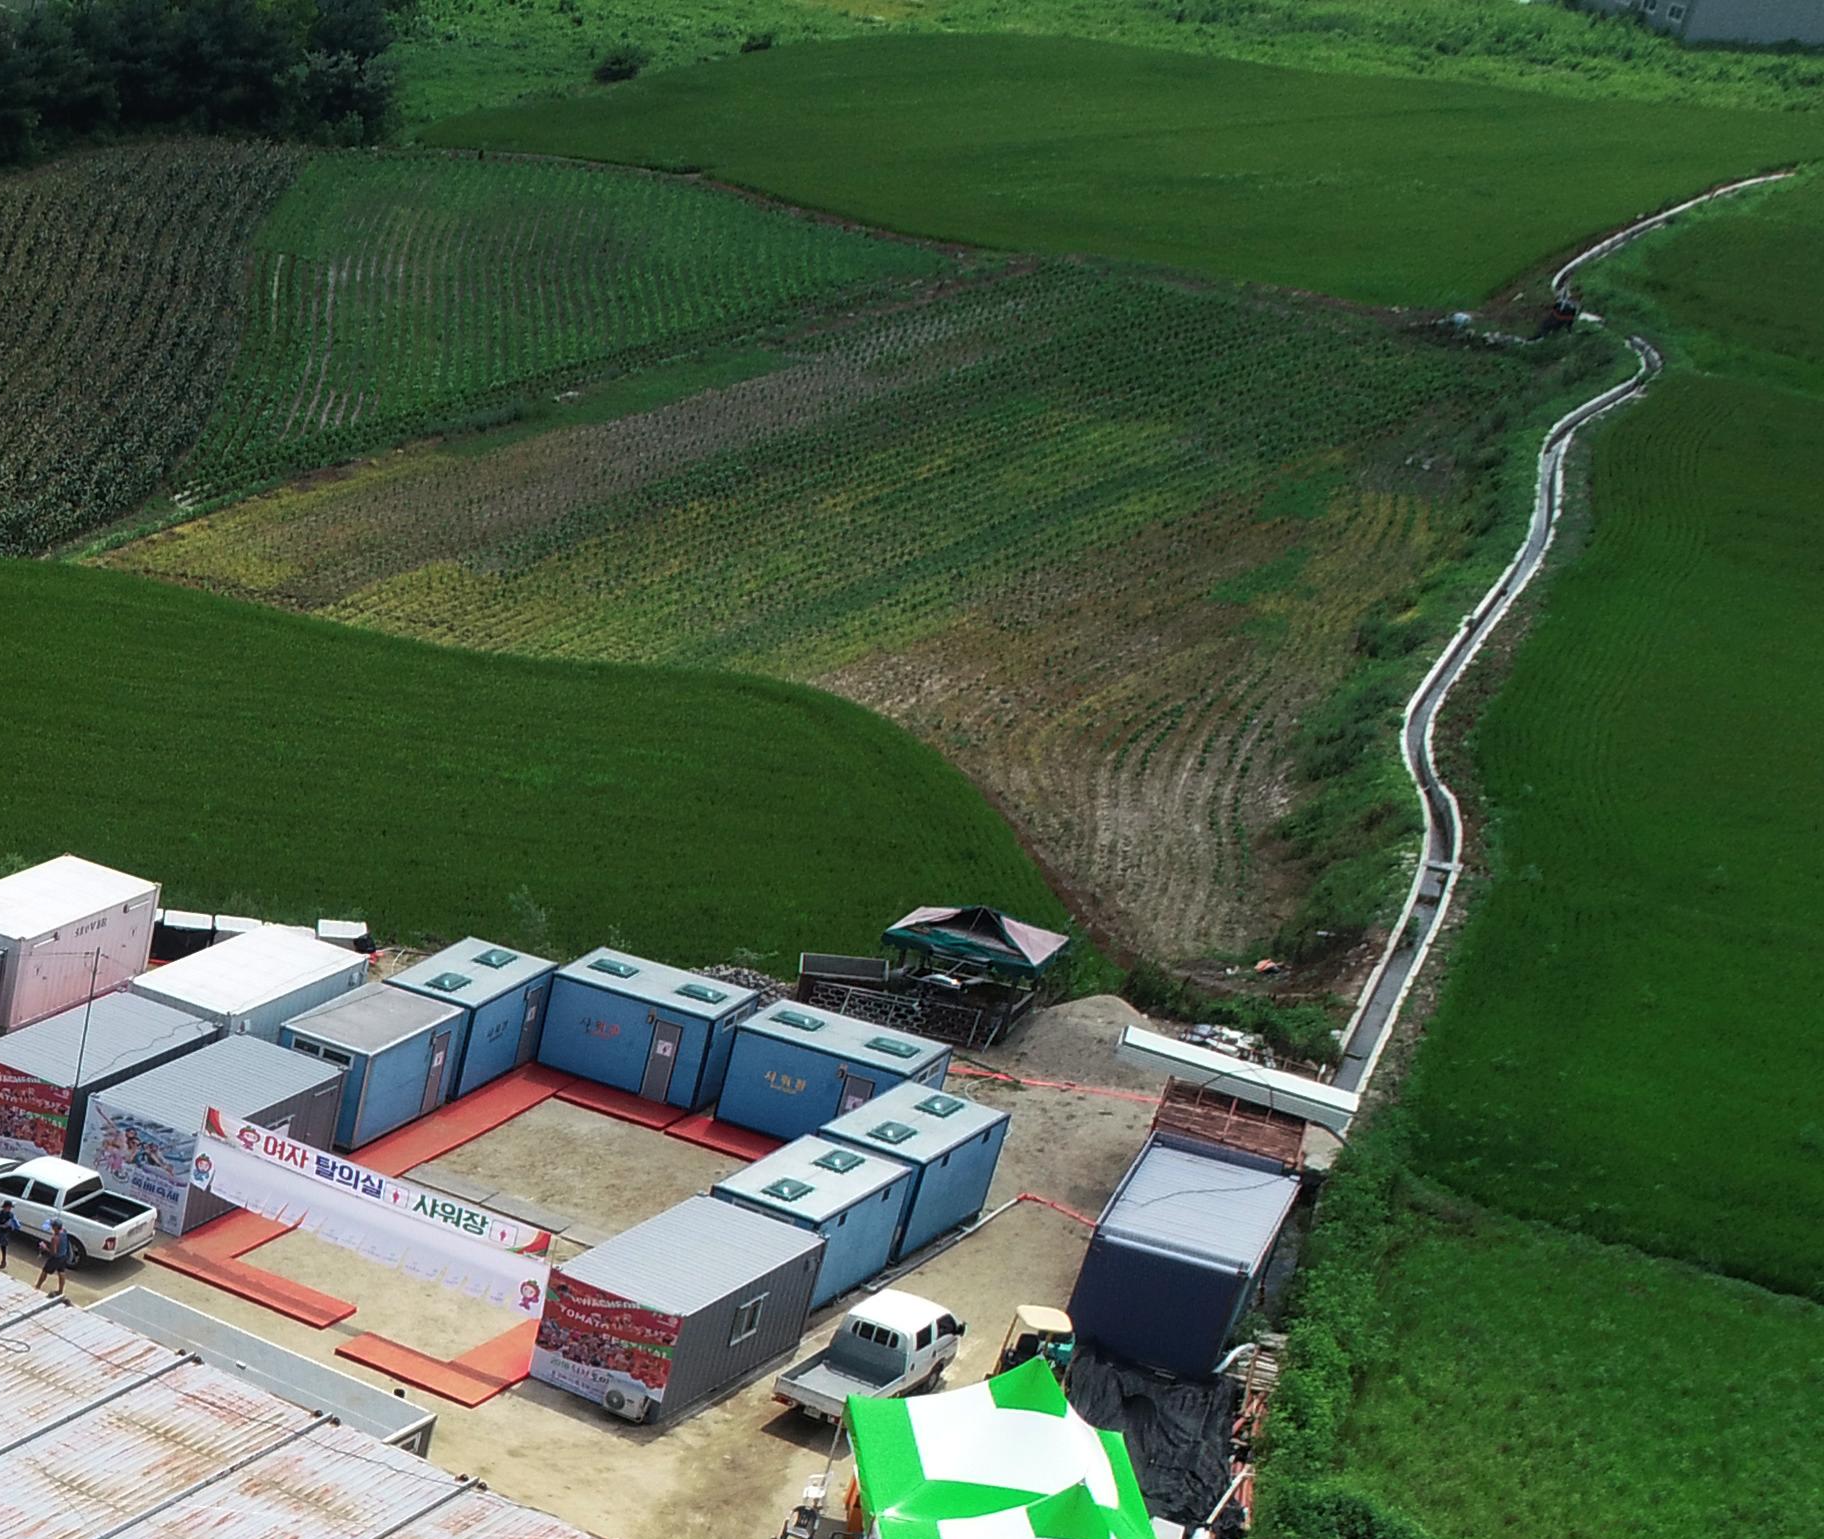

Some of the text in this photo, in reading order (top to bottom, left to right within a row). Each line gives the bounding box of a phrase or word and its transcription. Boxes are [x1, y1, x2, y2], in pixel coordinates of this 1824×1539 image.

[263, 1135, 489, 1237] 여자 탈의실 샤워장
[559, 1305, 610, 1330] TOMATO
